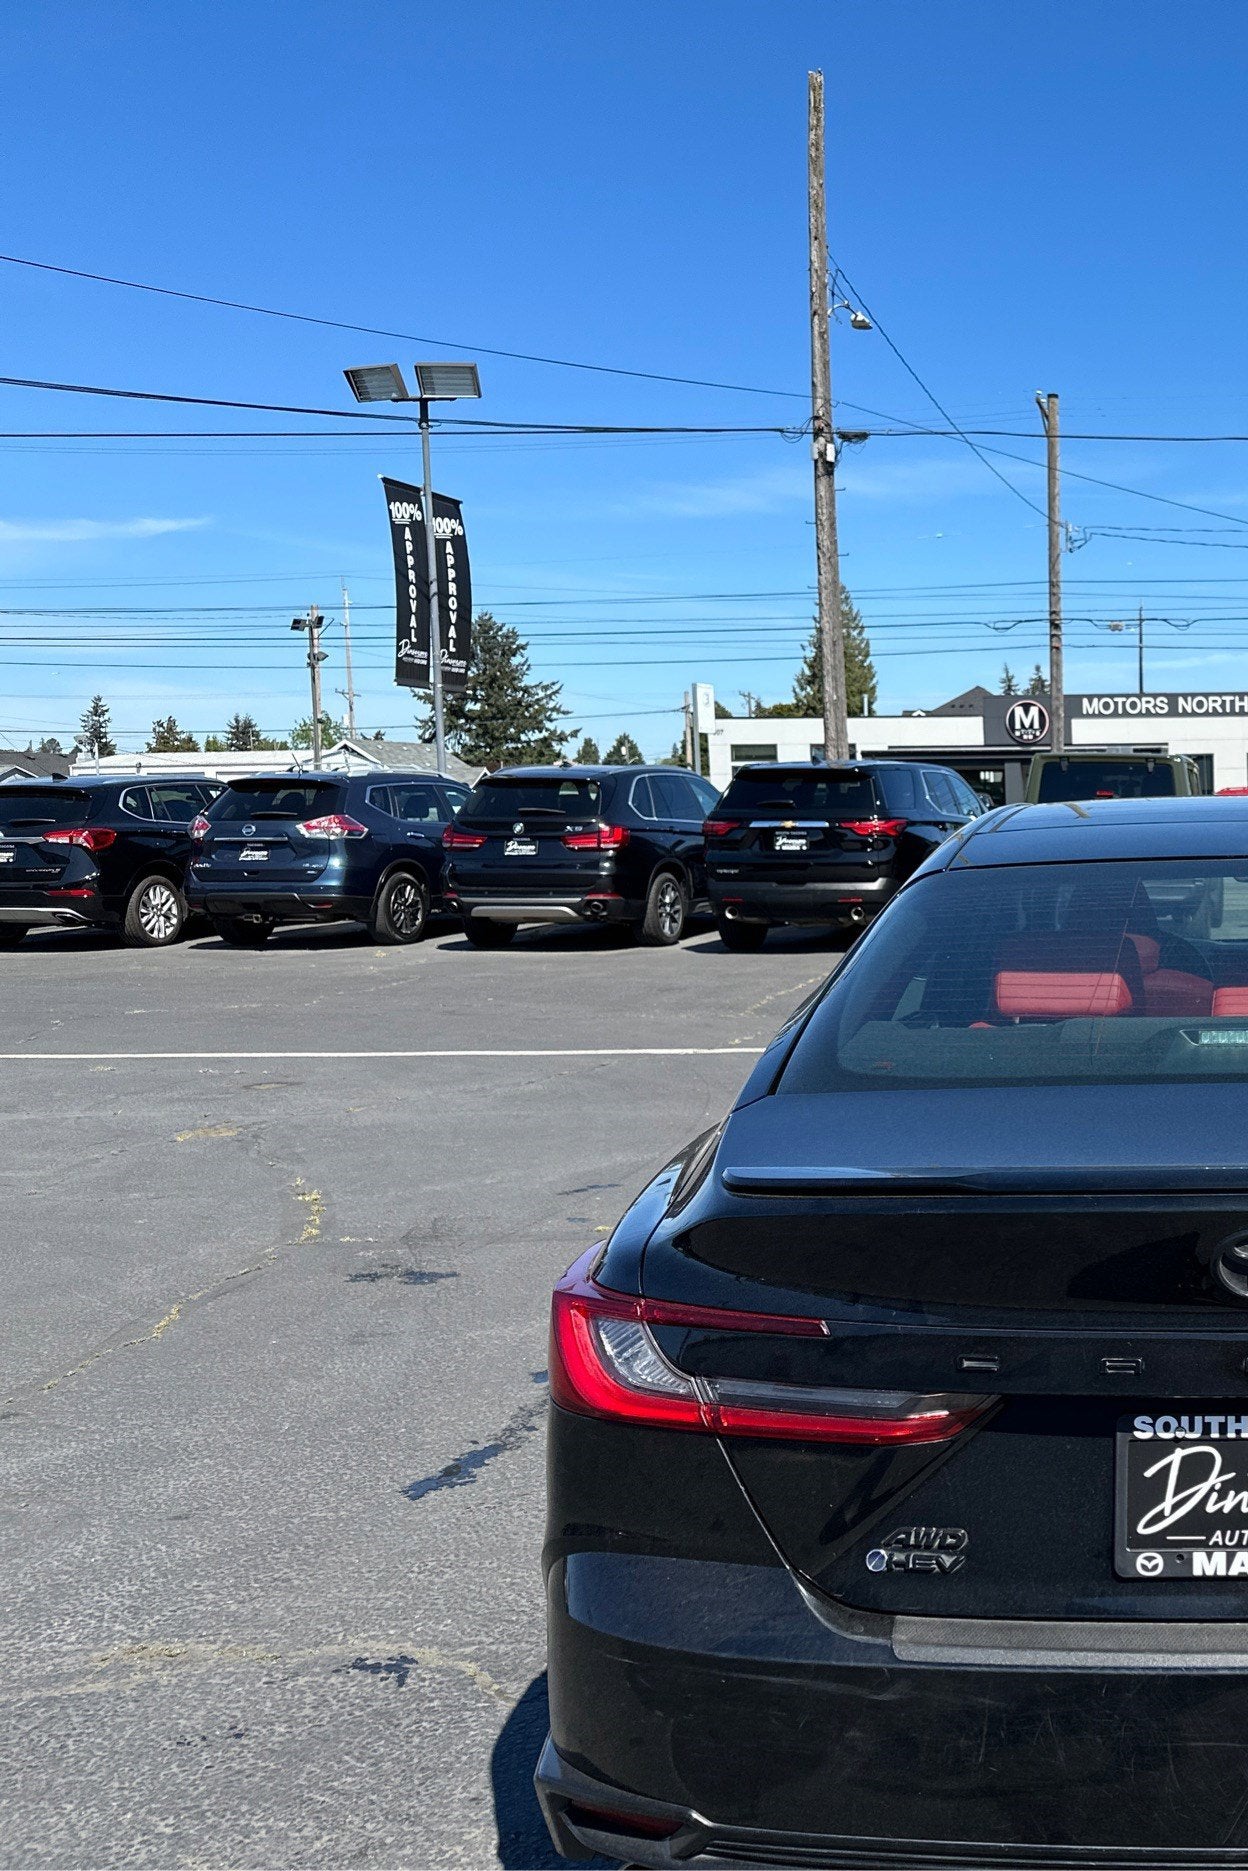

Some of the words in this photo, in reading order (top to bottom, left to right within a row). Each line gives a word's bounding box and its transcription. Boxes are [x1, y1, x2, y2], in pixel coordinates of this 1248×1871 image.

[389, 501, 422, 521] 100%
[432, 517, 464, 536] 100%
[404, 526, 417, 642] APPROVAL
[445, 541, 458, 652] APPROVAL
[1082, 697, 1169, 715] MOTORS
[882, 1526, 969, 1551] AWD
